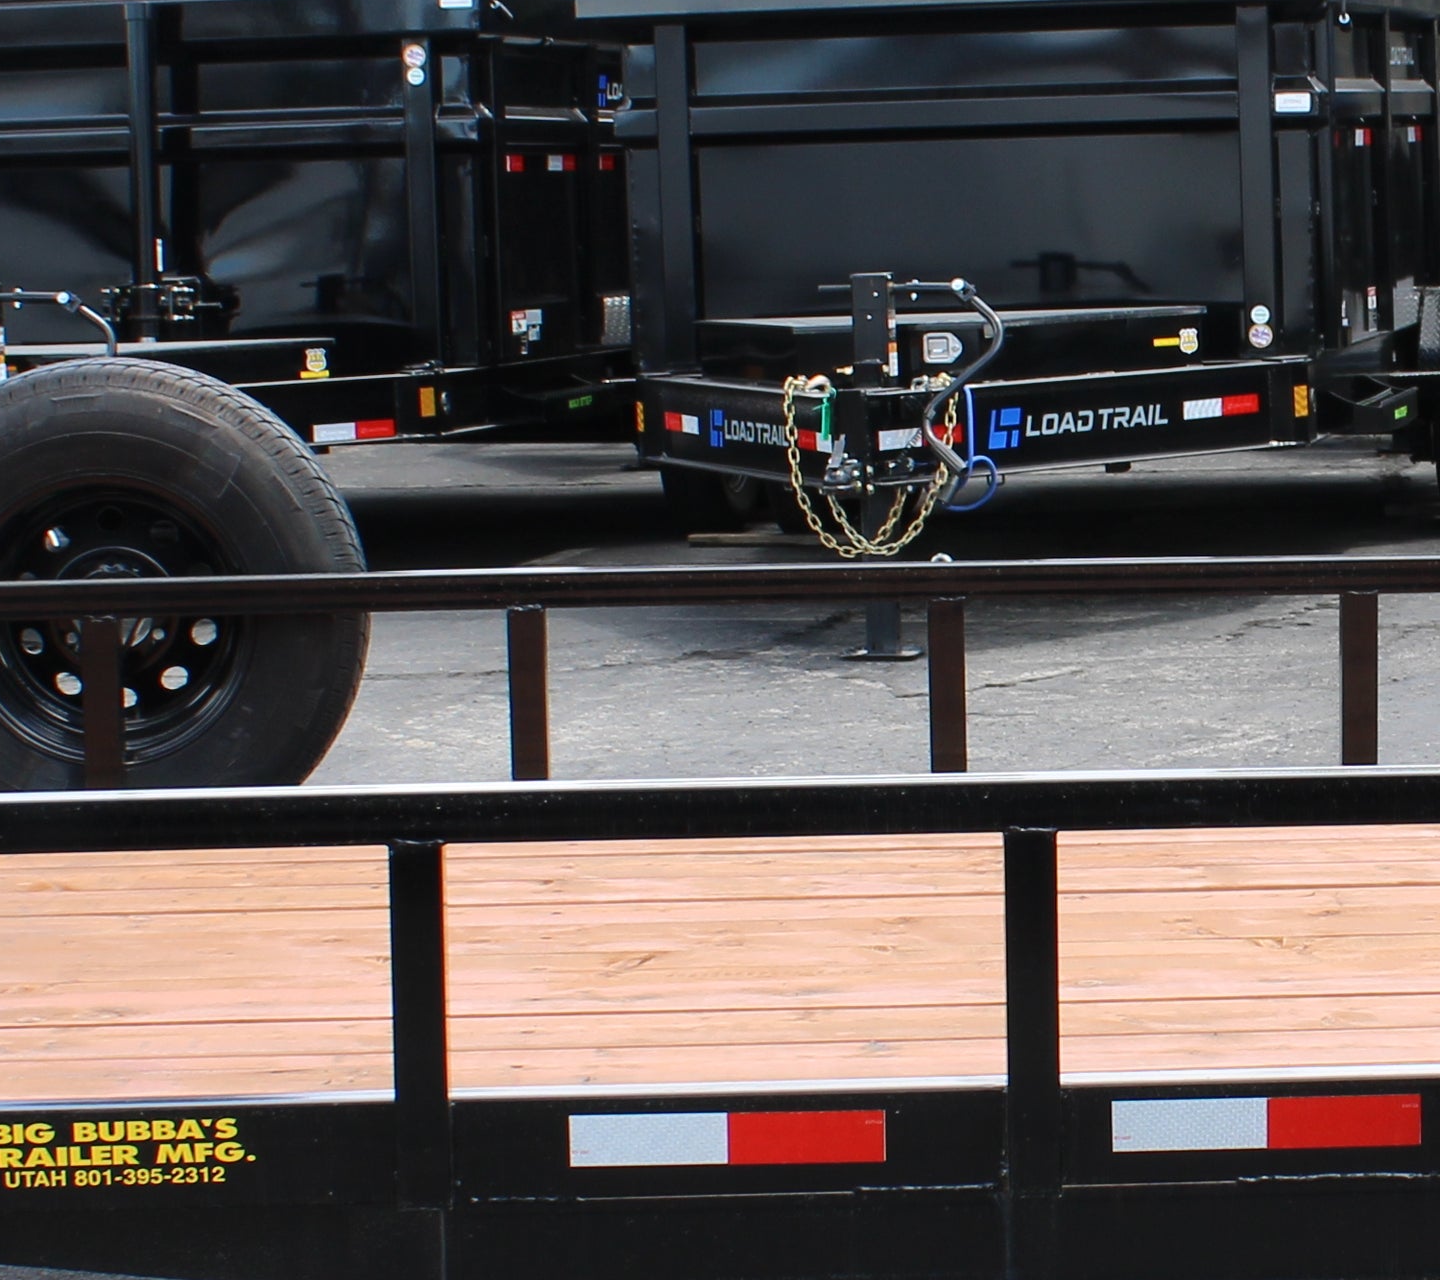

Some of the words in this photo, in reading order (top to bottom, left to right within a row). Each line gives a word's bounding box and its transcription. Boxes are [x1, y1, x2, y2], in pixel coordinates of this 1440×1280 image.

[724, 419, 754, 442] LOAD
[755, 423, 790, 447] TRAIL
[1025, 409, 1094, 437] LOAD
[1098, 403, 1169, 430] TRAIL
[73, 1117, 238, 1143] BUBBA'S
[155, 1141, 257, 1165] MFG.
[5, 1170, 67, 1188] UTAH
[74, 1166, 227, 1187] 801-395-2312
